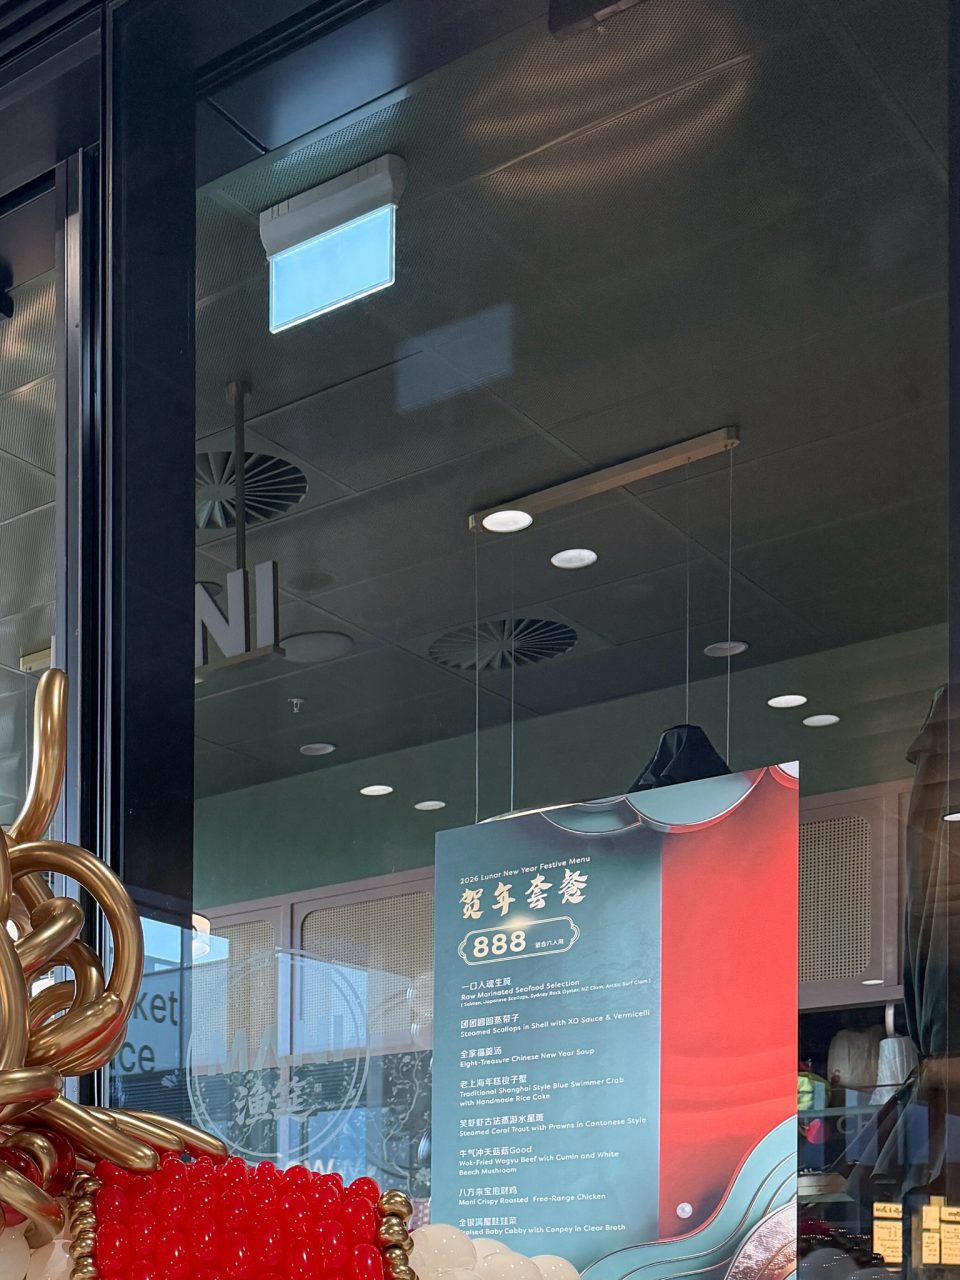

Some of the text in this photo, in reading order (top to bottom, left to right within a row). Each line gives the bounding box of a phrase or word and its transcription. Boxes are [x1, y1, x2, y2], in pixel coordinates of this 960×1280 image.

[460, 856, 591, 885] 2026 Lunar New Year Festive Menu
[459, 868, 589, 919] 贺年套餐
[473, 931, 526, 958] 888
[478, 988, 514, 999] Marinated
[515, 984, 545, 993] Seafood
[547, 980, 580, 990] Selection
[461, 1030, 491, 1038] Steamed
[493, 1026, 521, 1034] Scallops
[531, 1021, 549, 1029] Shell
[551, 1019, 567, 1027] with
[568, 1017, 579, 1025] XO
[581, 1015, 603, 1024] Sauce
[613, 1009, 650, 1020] Vermicelli
[460, 1057, 510, 1069] Eight-Treasure
[512, 1053, 539, 1062] Chinese
[460, 1088, 497, 1098] Traditional
[499, 1084, 531, 1094] Shanghai
[533, 1083, 551, 1092] Style
[571, 1079, 605, 1089] Swimmer
[606, 1077, 625, 1085] Crab
[476, 1097, 514, 1106] Handmade
[460, 1129, 490, 1137] Steamed
[491, 1127, 510, 1135] Coral
[512, 1125, 530, 1133] Trout
[549, 1123, 574, 1131] Prawns
[586, 1119, 626, 1128] Cantonese
[627, 1117, 647, 1126] Style
[459, 1159, 493, 1167] Wok-Fried
[495, 1158, 519, 1166] Wagyu
[556, 1153, 579, 1161] Cumin
[481, 1167, 517, 1175] Mushroom
[478, 1198, 499, 1206] Crispy
[533, 1195, 575, 1203] Free-Range
[486, 1228, 502, 1236] Baby
[505, 1227, 527, 1235] Cabby
[546, 1226, 573, 1234] Conpoy
[584, 1224, 603, 1232] Clear
